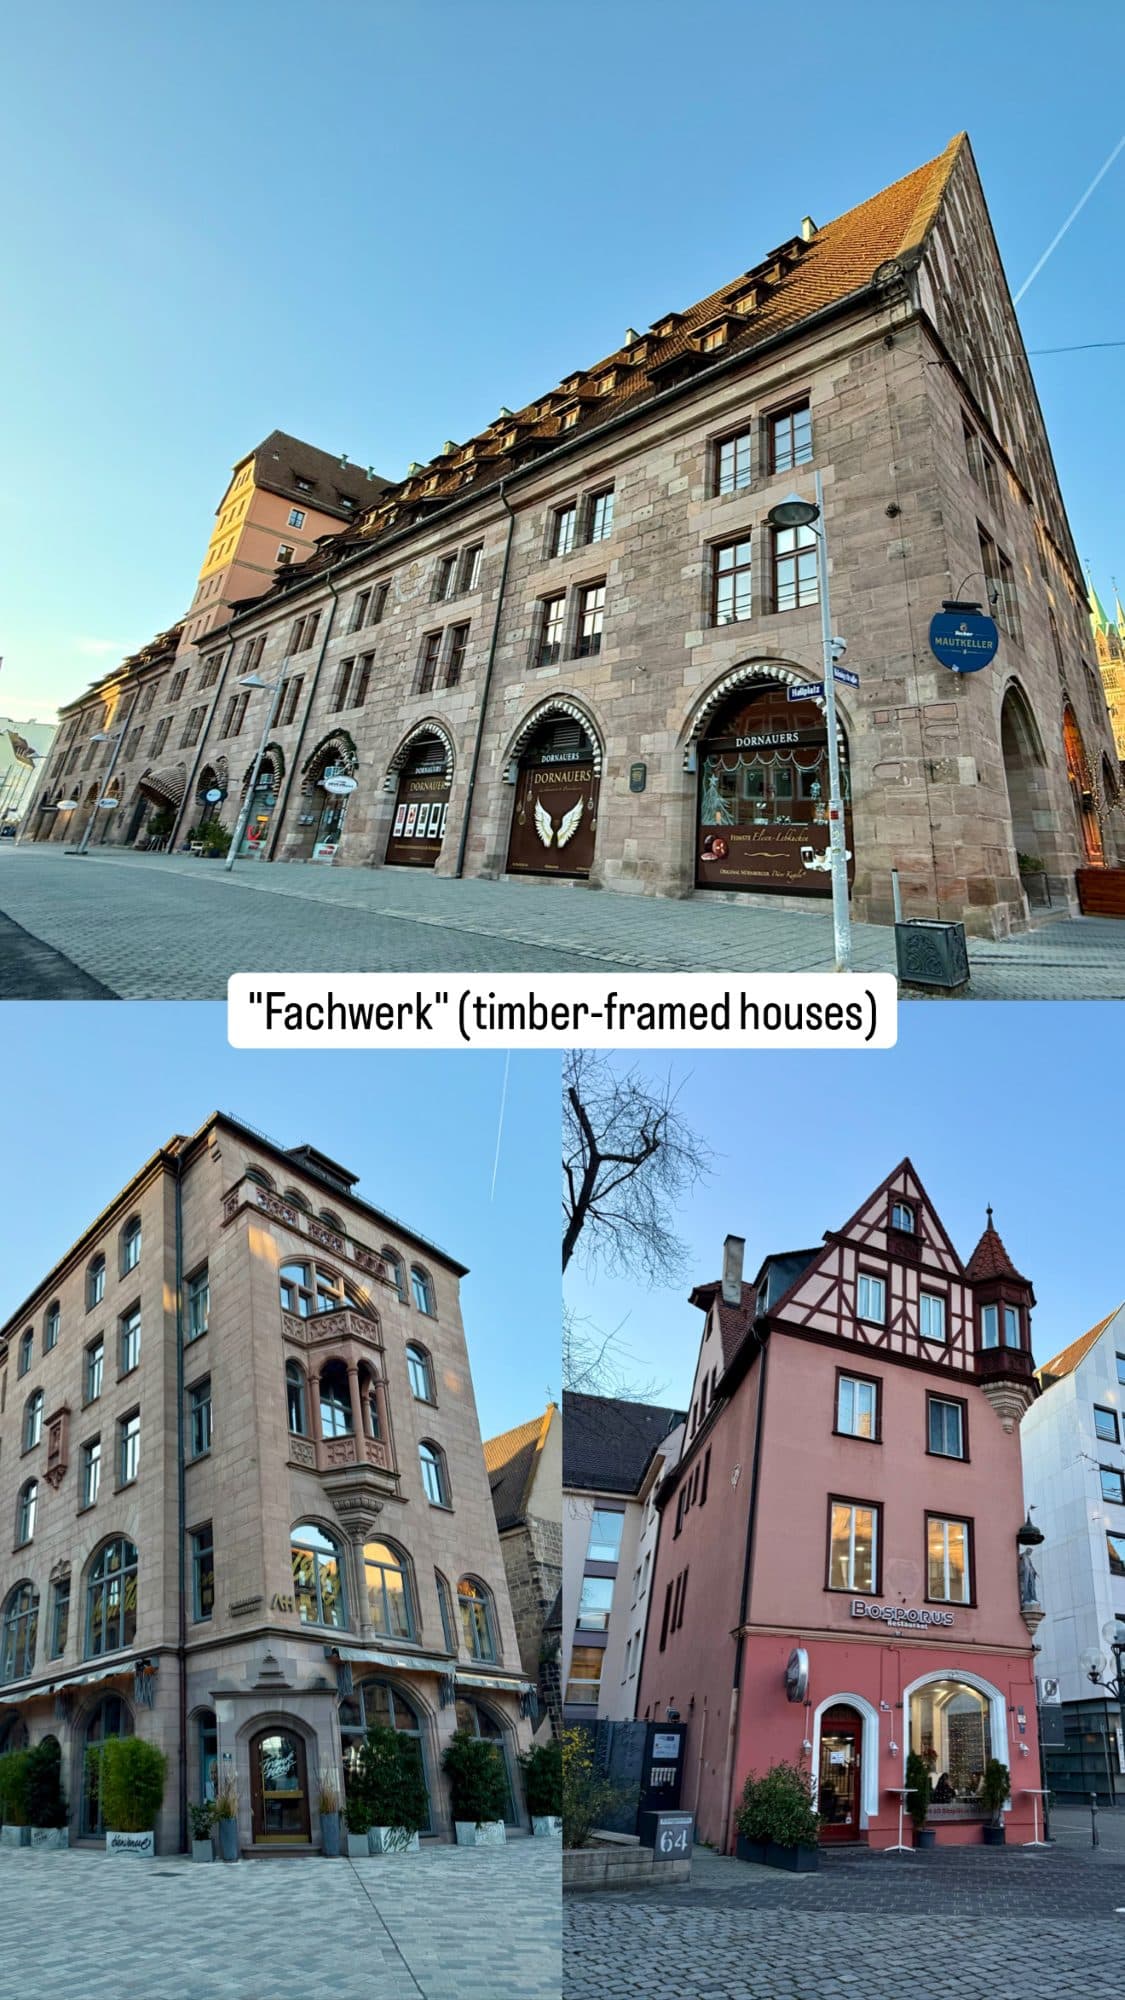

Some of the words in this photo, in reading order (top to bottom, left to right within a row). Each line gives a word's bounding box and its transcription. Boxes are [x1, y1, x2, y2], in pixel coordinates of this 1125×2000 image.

[935, 637, 993, 649] MAUTKELLER
[791, 685, 820, 697] Hallplatz
[736, 732, 799, 747] DORNAUERS
[541, 752, 580, 763] DORNAUERS
[534, 769, 592, 784] DORNAUERS
[851, 1600, 955, 1626] BOSPORUS
[887, 1619, 928, 1630] Restaurant
[660, 1830, 688, 1853] 64
